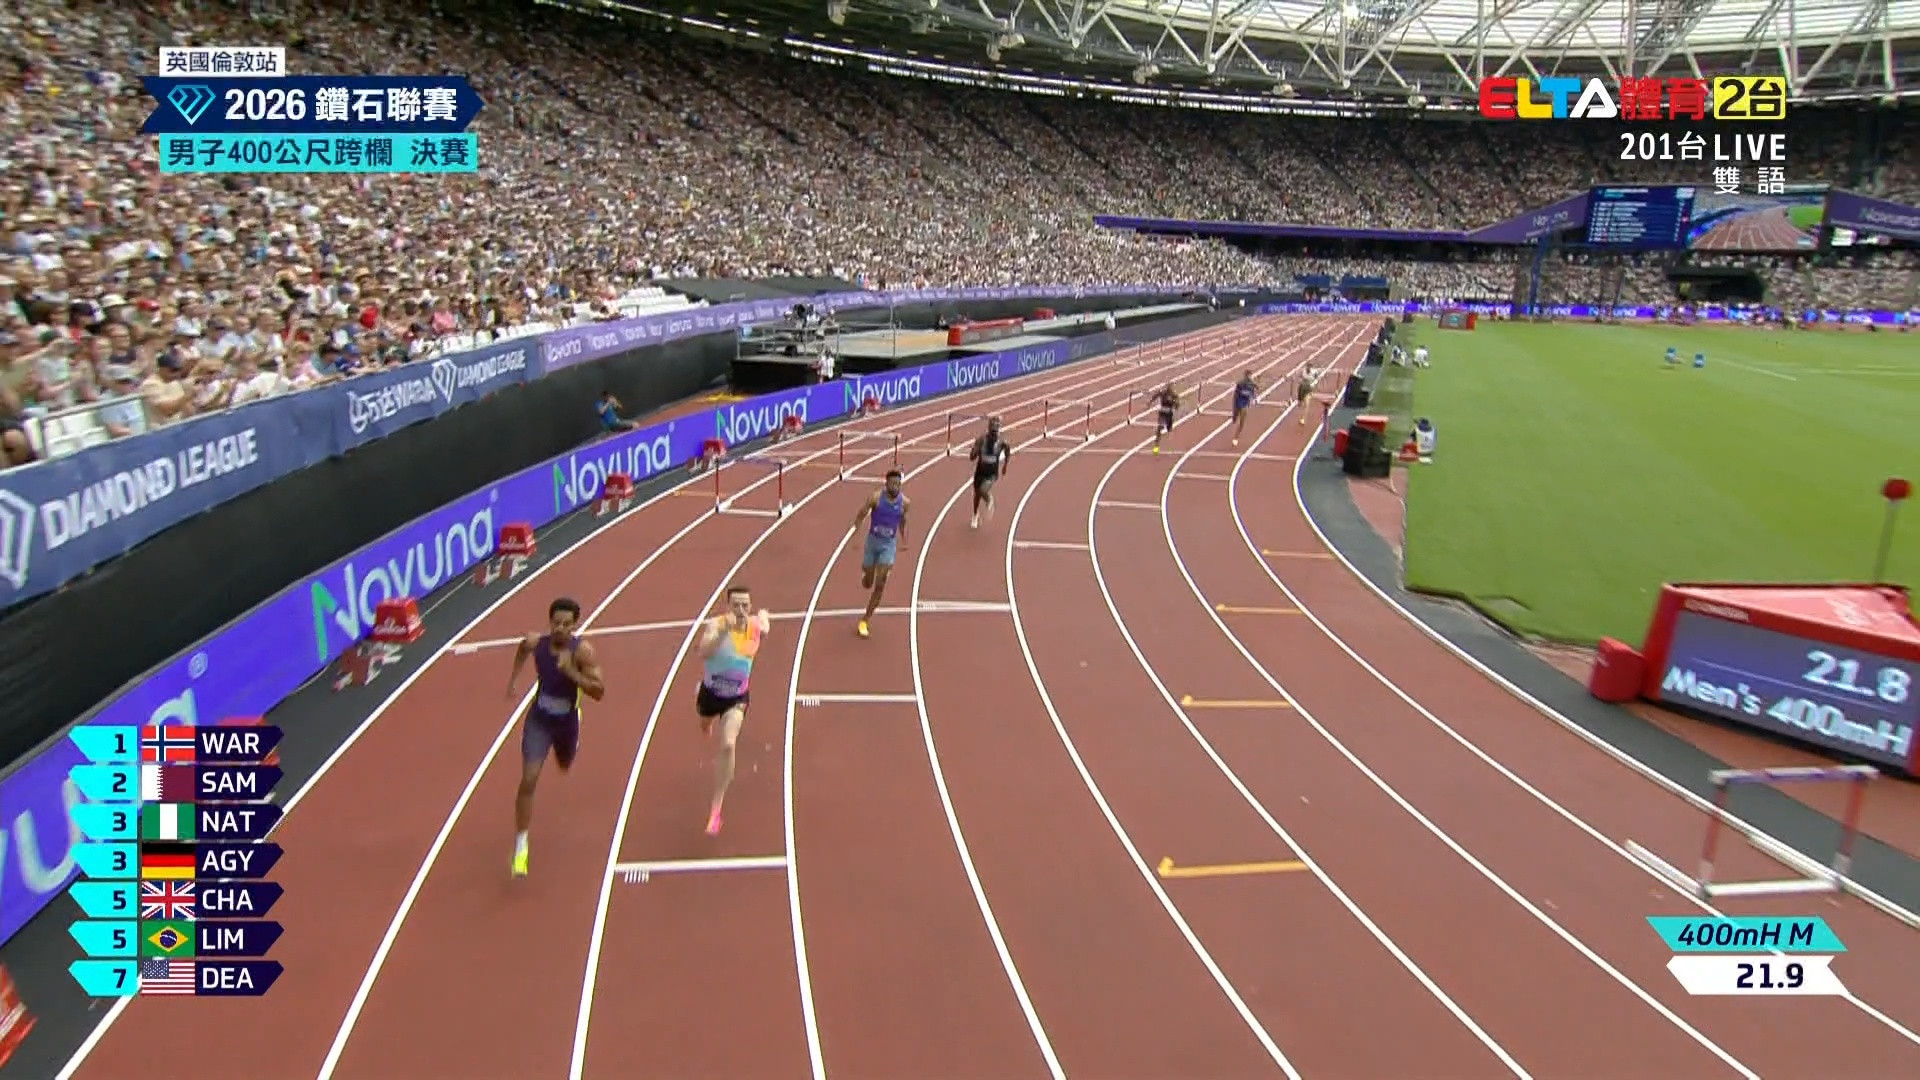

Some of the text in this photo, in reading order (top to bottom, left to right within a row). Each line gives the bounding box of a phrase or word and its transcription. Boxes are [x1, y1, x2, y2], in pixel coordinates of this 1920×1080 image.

[844, 376, 921, 413] Novuna
[947, 359, 1000, 389] Novuna
[717, 396, 808, 445] Novuna
[40, 428, 259, 550] DIAMOND LEAGUE
[553, 434, 671, 515] Novuna
[311, 505, 495, 663] Novuna
[1802, 650, 1912, 704] 21.8
[1662, 665, 1913, 757] Men's 400mH
